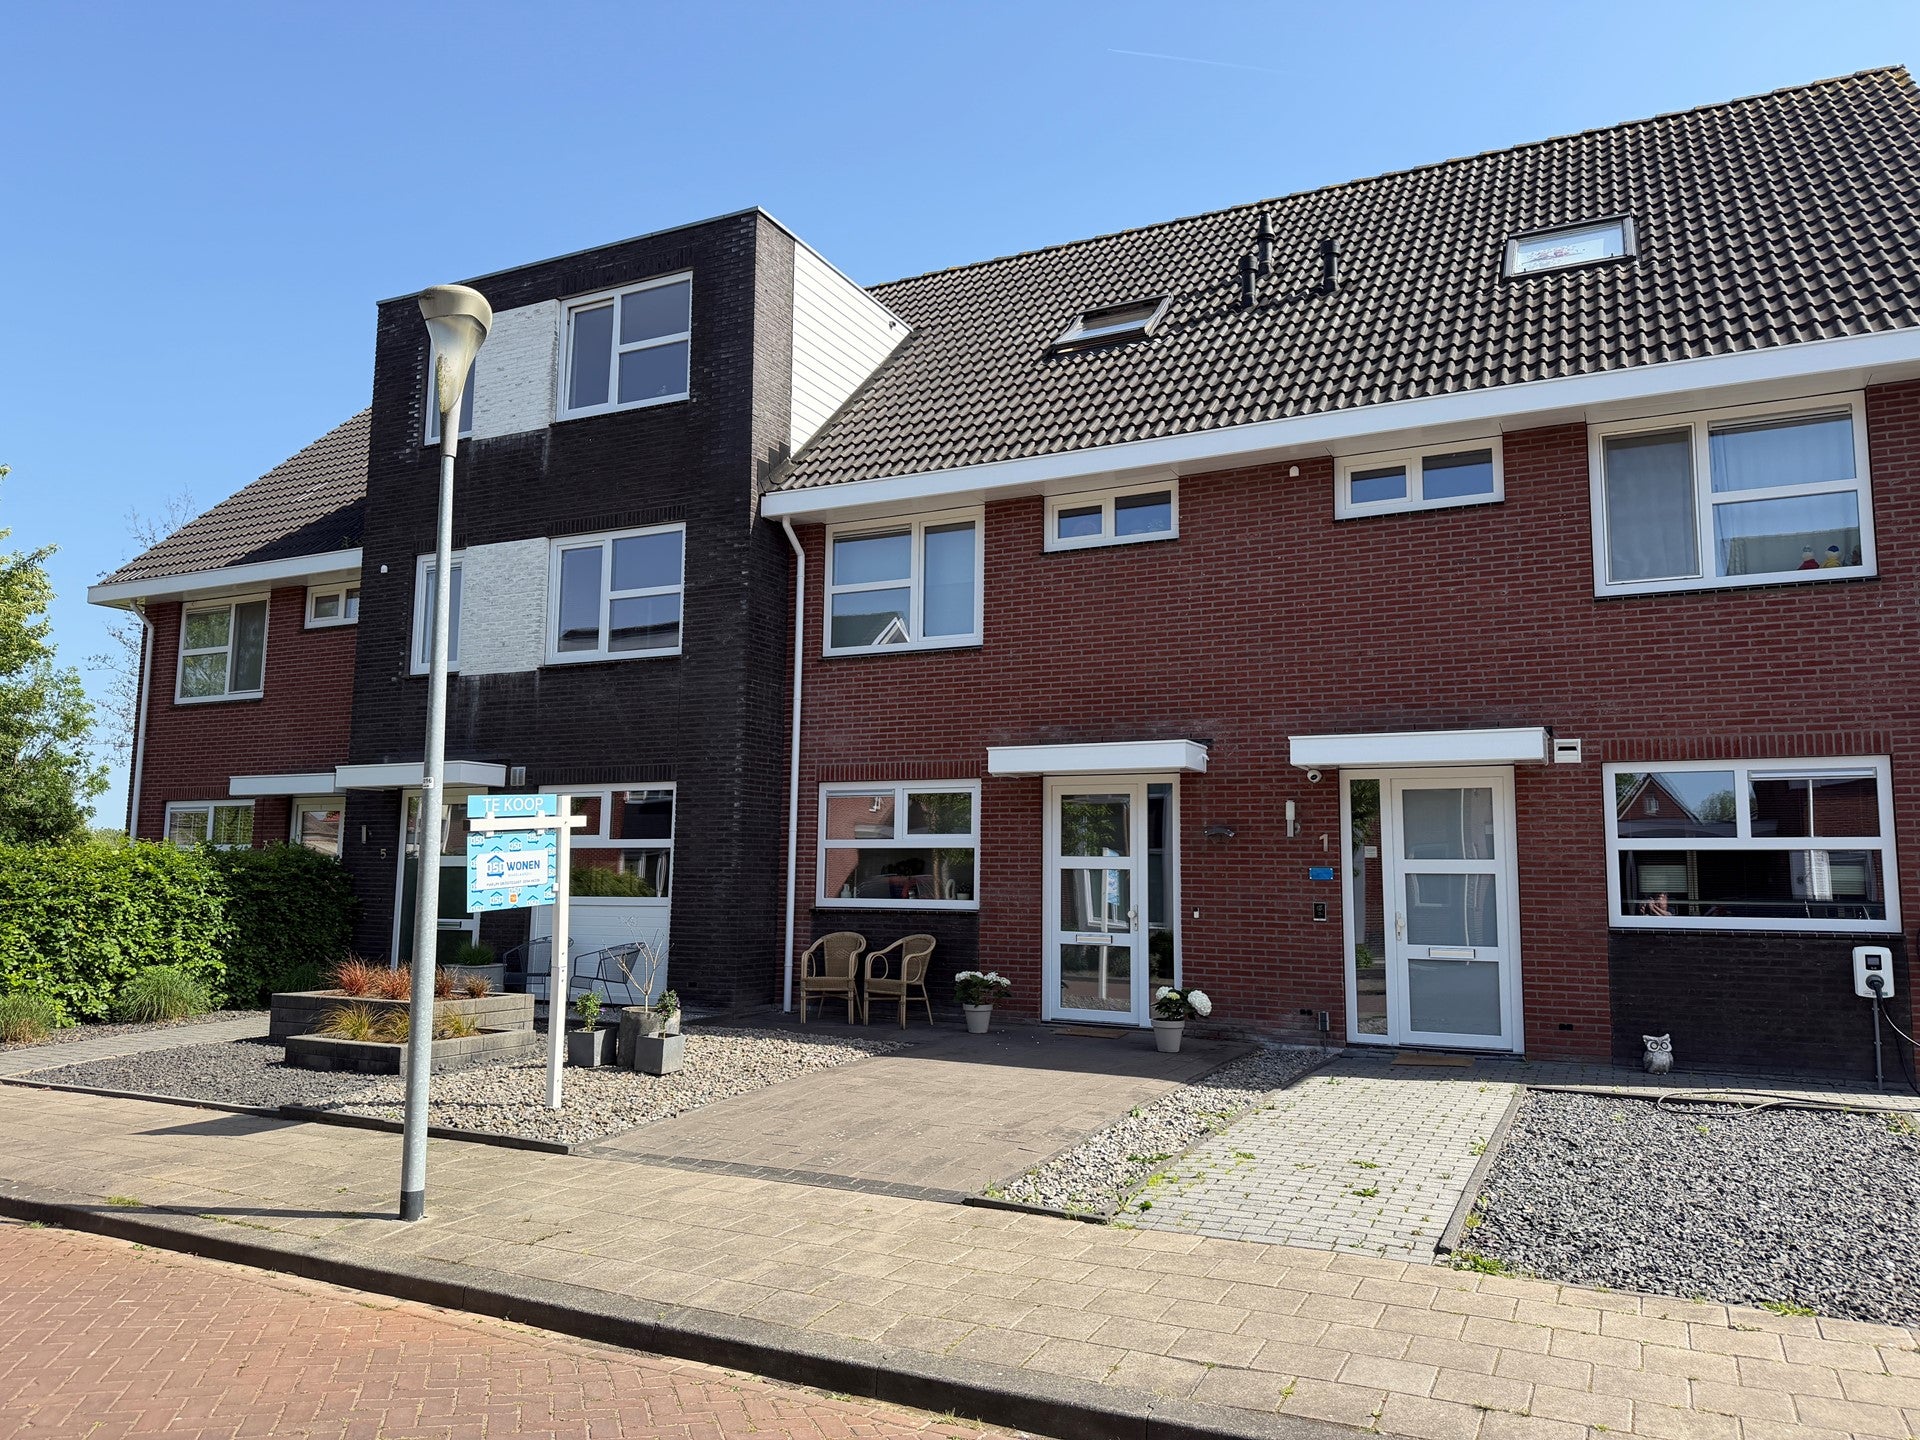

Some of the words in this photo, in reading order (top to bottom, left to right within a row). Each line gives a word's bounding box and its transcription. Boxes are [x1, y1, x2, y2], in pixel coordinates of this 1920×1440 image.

[483, 798, 501, 812] TE
[504, 797, 544, 812] KOOP
[1318, 833, 1329, 852] 1
[380, 848, 387, 860] 5
[506, 859, 541, 871] WONEN
